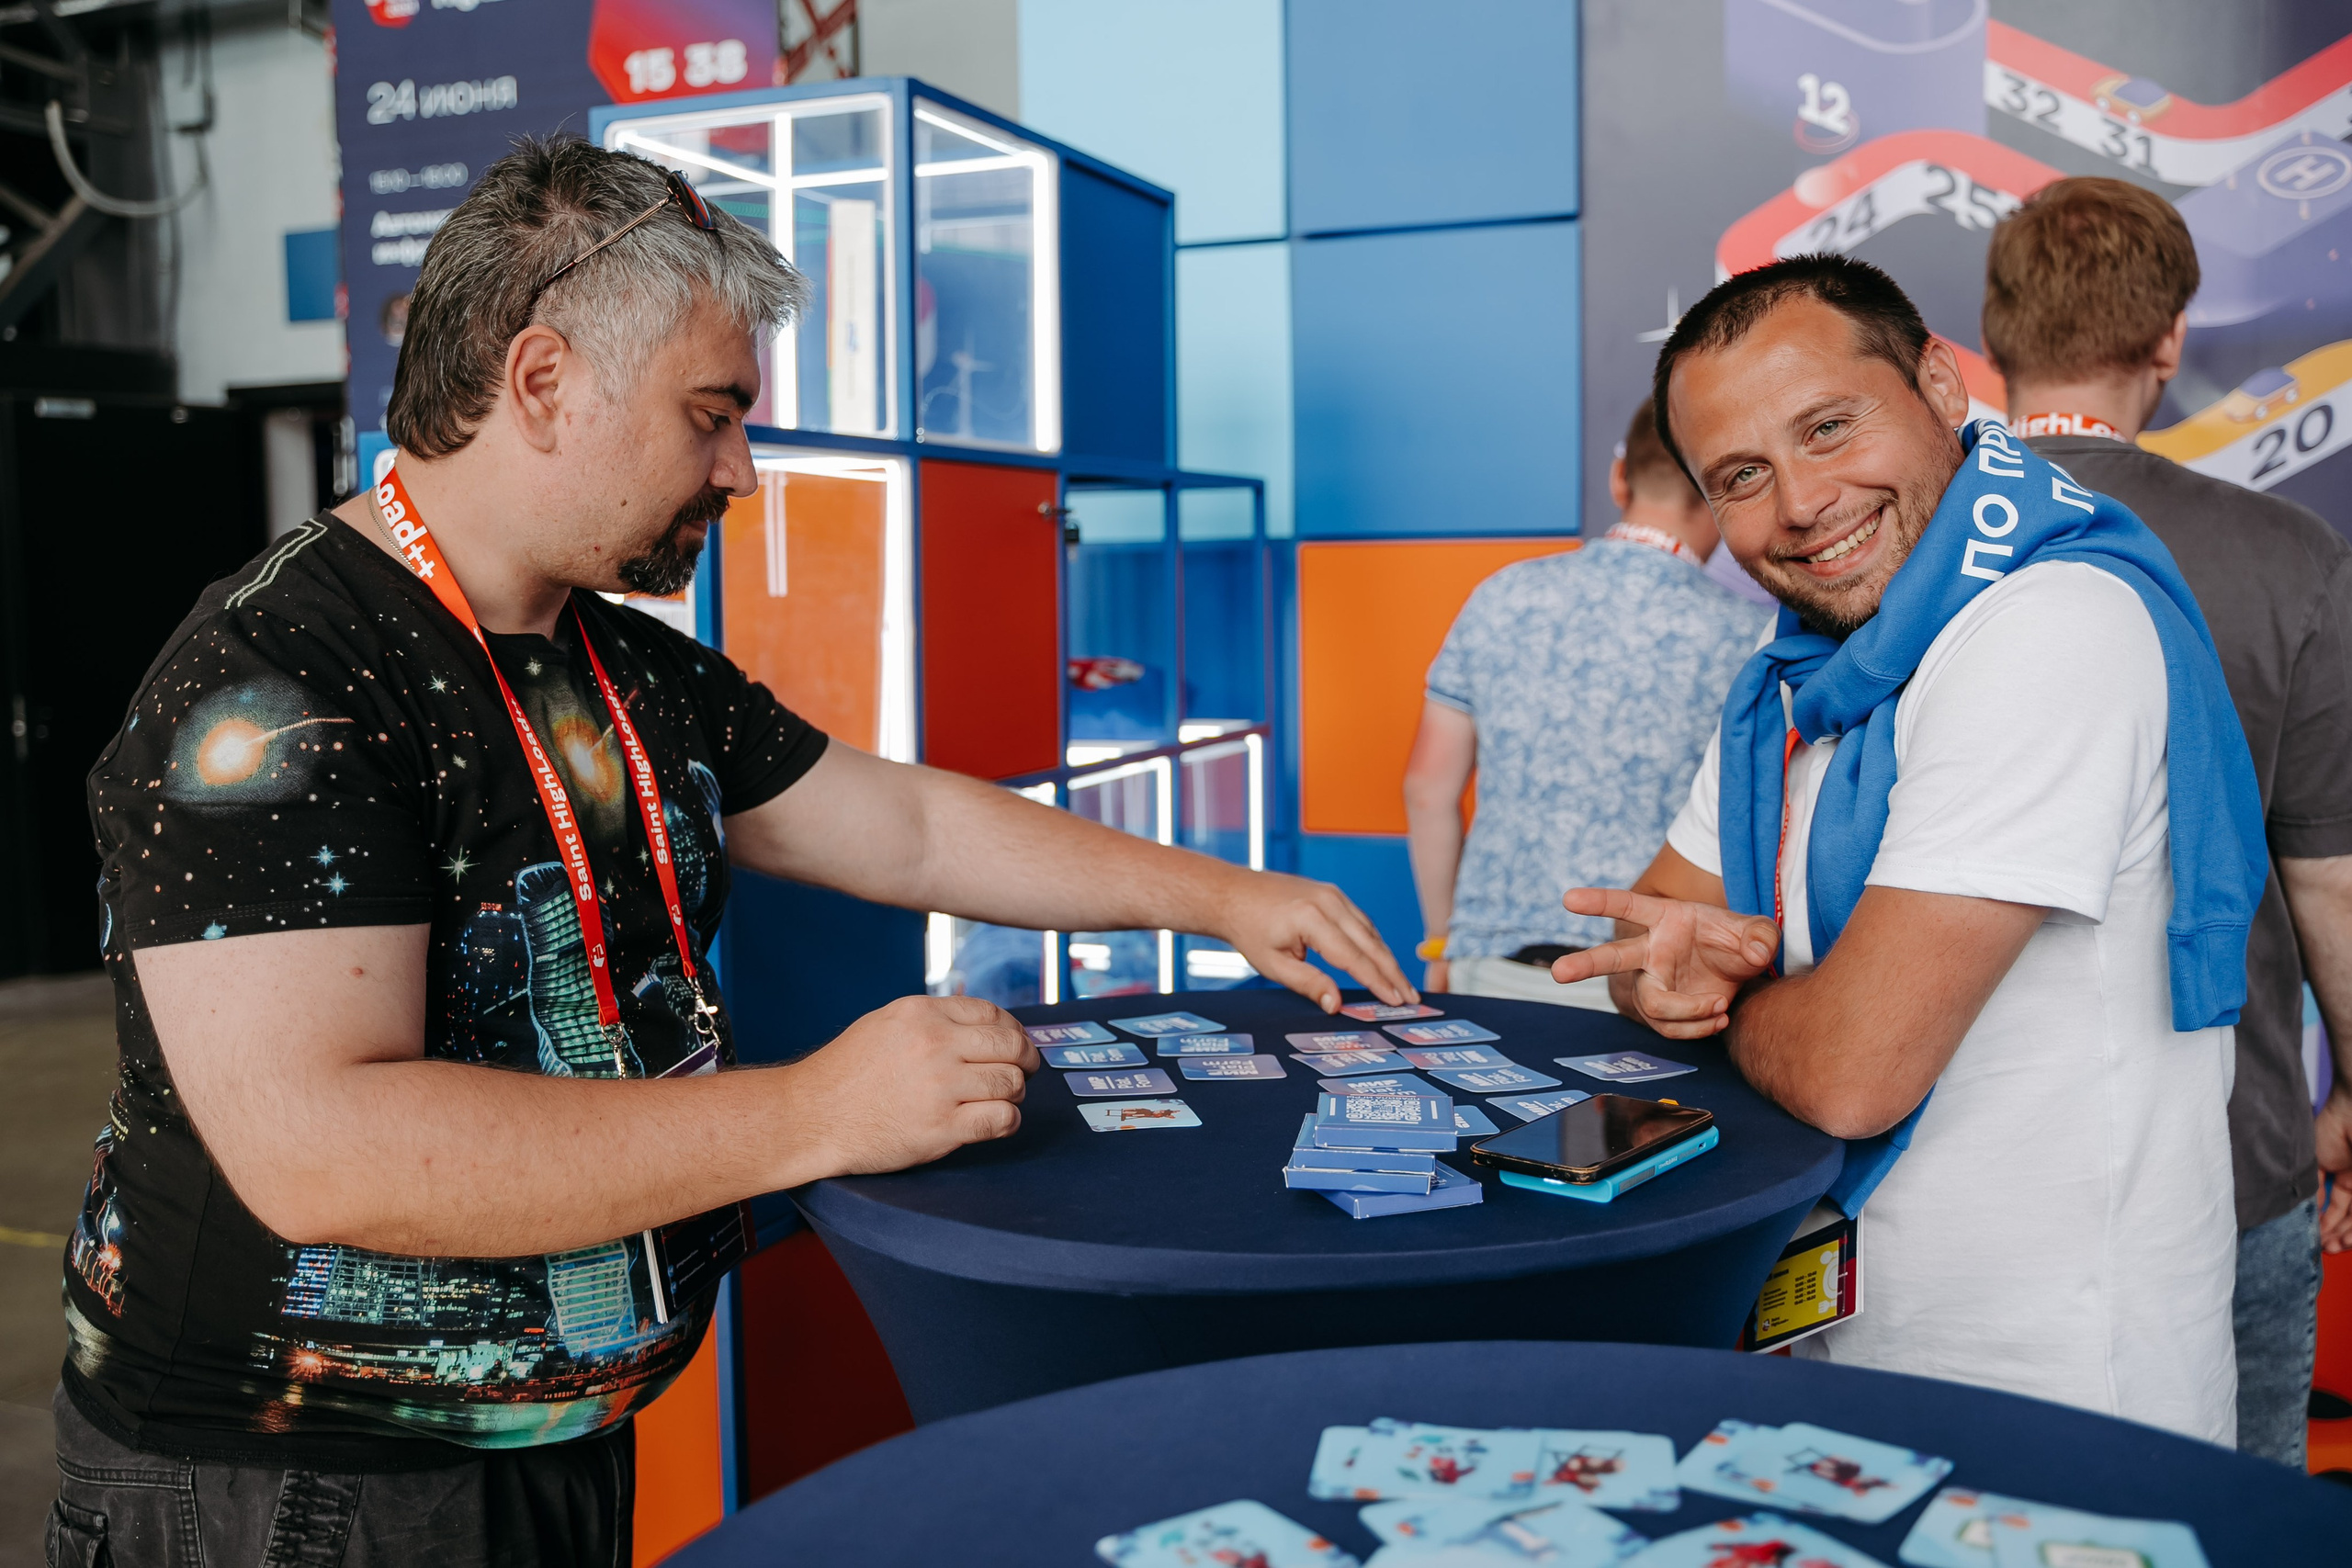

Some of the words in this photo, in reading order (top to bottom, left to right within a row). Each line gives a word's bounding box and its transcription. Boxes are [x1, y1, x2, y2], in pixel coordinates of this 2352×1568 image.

[367, 78, 415, 125] 24
[419, 75, 517, 119] июня
[624, 47, 677, 94] 15
[2001, 71, 2061, 131] 32
[1797, 73, 1851, 136] 12
[2102, 116, 2159, 176] 31
[1808, 190, 1876, 250] 24
[1925, 164, 2001, 231] 25
[2251, 404, 2334, 480] 20
[376, 482, 436, 580] oad++
[1961, 493, 2019, 582] ПО
[511, 697, 572, 829] HighLoad++
[603, 678, 654, 797] HighLoad++
[647, 801, 669, 864] Saint
[565, 833, 593, 902] Saint
[1347, 1079, 1398, 1089] МИР
